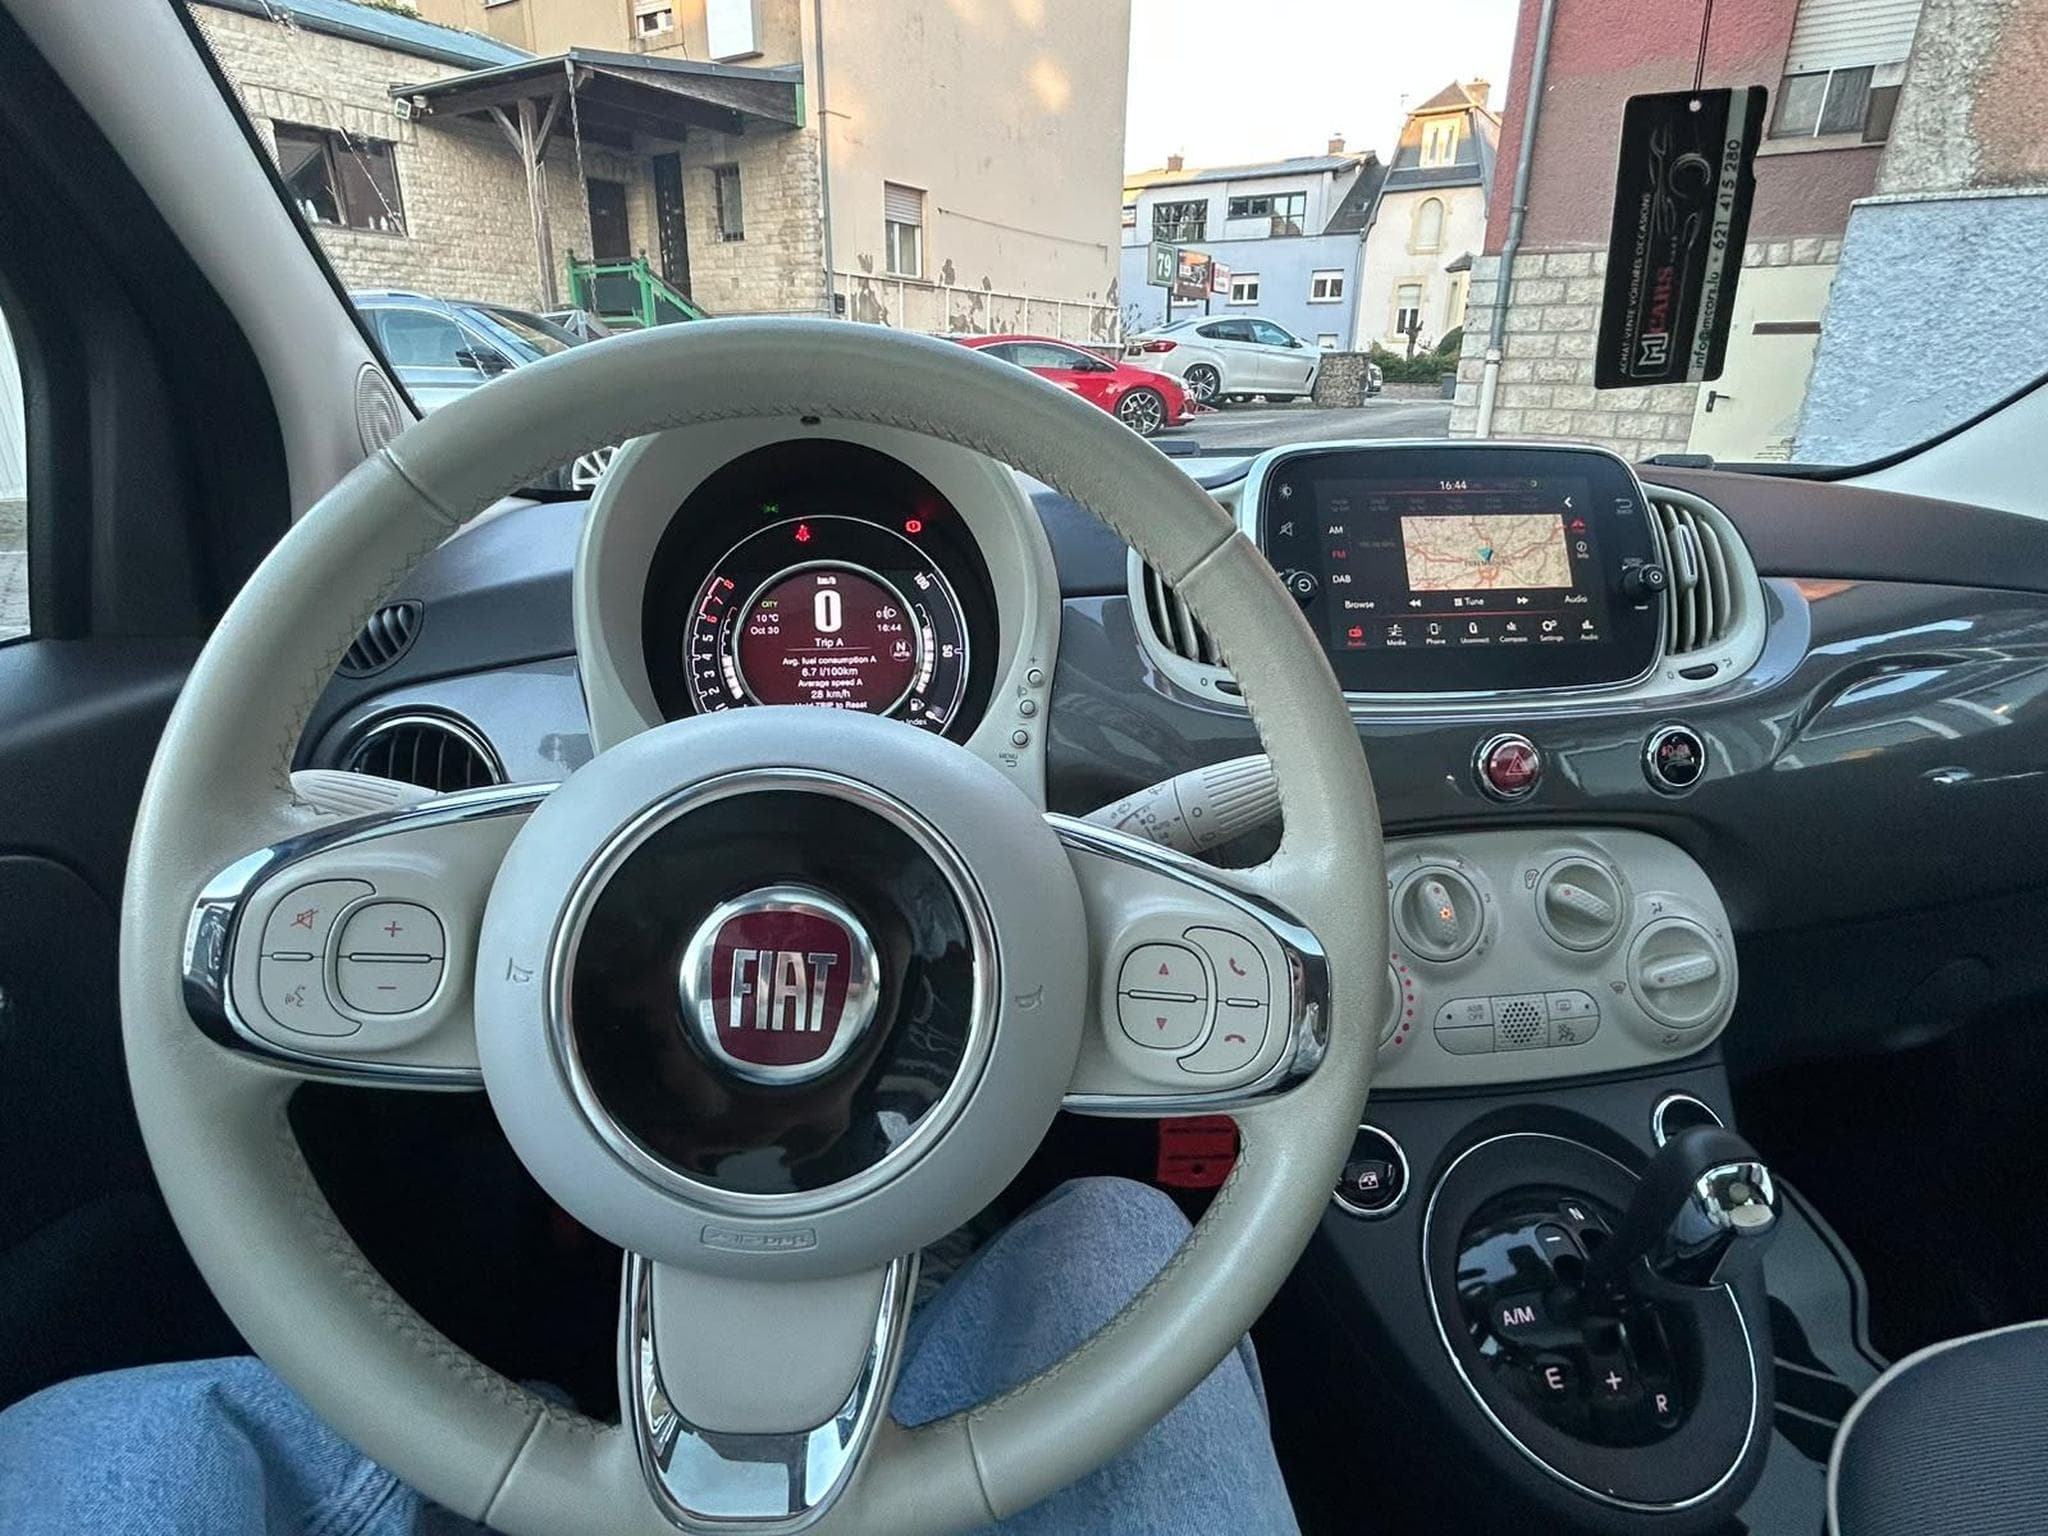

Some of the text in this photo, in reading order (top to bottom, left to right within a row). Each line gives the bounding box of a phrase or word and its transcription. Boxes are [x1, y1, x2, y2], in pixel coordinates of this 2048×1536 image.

[1724, 140, 1740, 172] 280
[1720, 180, 1735, 212] 415
[1712, 221, 1728, 250] 621
[1157, 252, 1172, 277] 79
[1440, 480, 1467, 490] 16:44
[1329, 525, 1343, 534] AM
[914, 572, 930, 590] 100
[1332, 575, 1351, 583] DAB
[1464, 597, 1484, 605] Tune
[1564, 595, 1588, 603] Audio
[1345, 601, 1375, 609] Browse
[814, 590, 843, 633] 0
[750, 626, 780, 635] Oct 30
[702, 634, 714, 642] 5
[814, 638, 844, 649] Trip A
[896, 641, 906, 651] N
[942, 644, 953, 658] 50
[782, 657, 800, 666] Avg.
[818, 655, 868, 665] consumption
[801, 667, 817, 677] 6.7
[798, 679, 829, 688] Average
[856, 678, 863, 686] A
[826, 689, 851, 699] km/h
[729, 949, 838, 1032] FIAT
[1569, 1207, 1585, 1221] N
[1502, 1308, 1535, 1326] A/M
[1545, 1367, 1564, 1390] E
[1655, 1394, 1668, 1412] R
